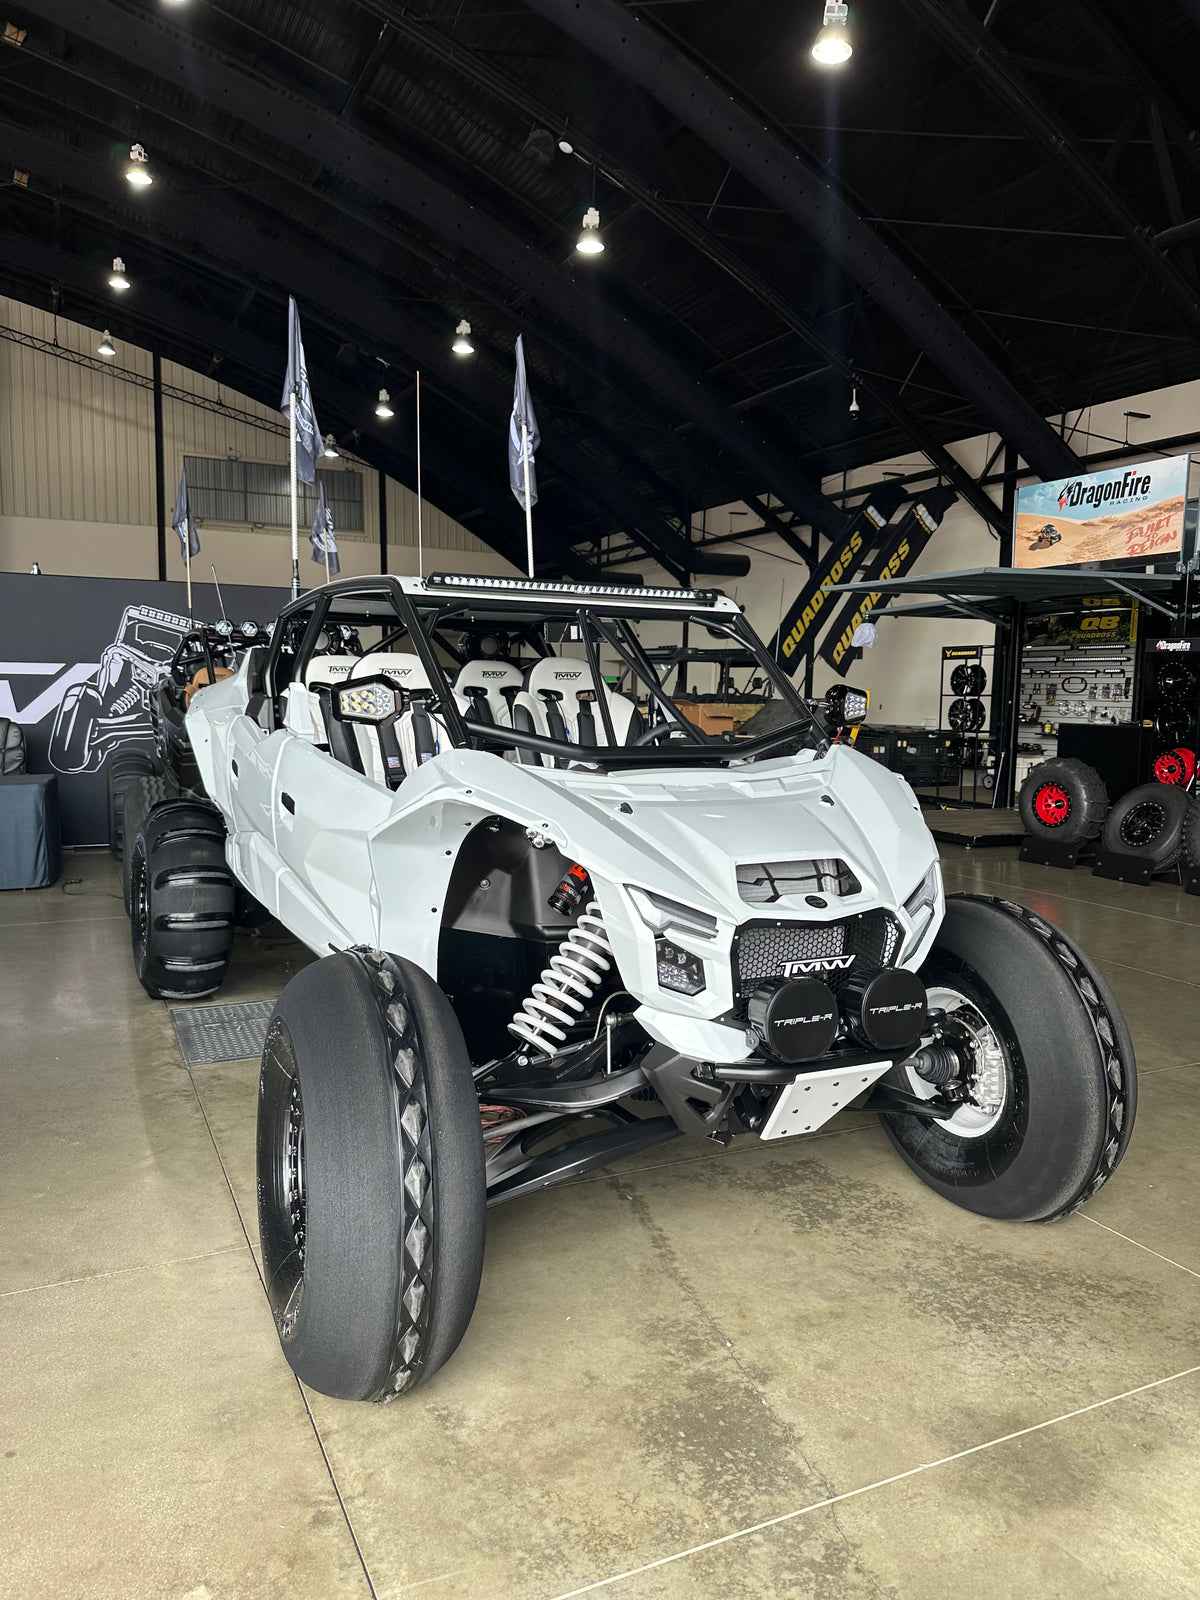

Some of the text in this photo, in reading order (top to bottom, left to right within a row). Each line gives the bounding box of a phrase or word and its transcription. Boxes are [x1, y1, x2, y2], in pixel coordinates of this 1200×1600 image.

[1069, 471, 1151, 508] DragonFire
[1109, 495, 1149, 506] RACING
[1126, 515, 1174, 544] BUILT
[1127, 530, 1178, 557] REIGN
[782, 531, 863, 658] QUADBOSS
[1080, 616, 1120, 631] QB
[778, 955, 856, 978] TMW
[774, 1013, 833, 1027] TRIPLE-R
[870, 1002, 923, 1015] TRIPLE-R
